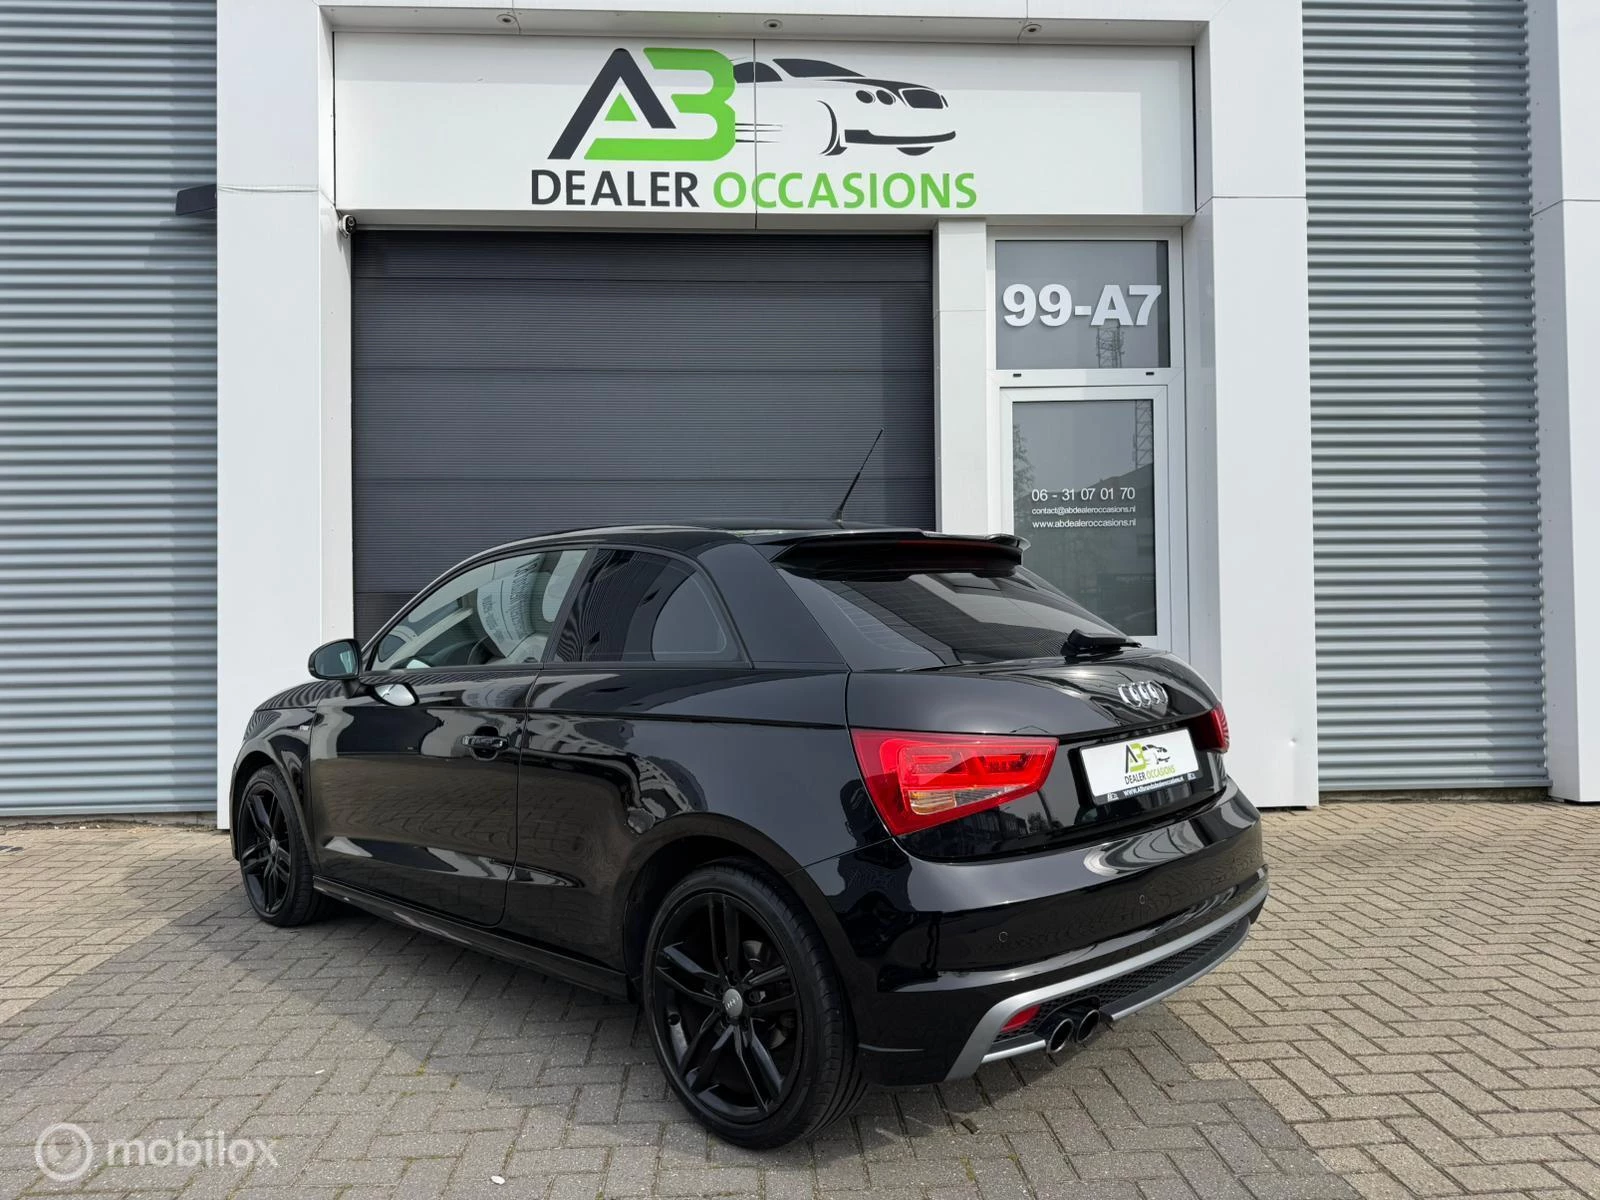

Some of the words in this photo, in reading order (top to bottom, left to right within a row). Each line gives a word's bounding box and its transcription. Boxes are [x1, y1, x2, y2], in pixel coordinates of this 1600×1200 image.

[531, 169, 700, 208] DEALER
[713, 171, 977, 209] OCCASIONS
[1003, 283, 1162, 327] 99-A7
[1031, 488, 1048, 501] 06
[1061, 488, 1075, 501] 31
[1080, 488, 1096, 500] 07
[1100, 487, 1114, 500] 01
[1120, 487, 1136, 500] 70
[1031, 505, 1136, 515] contact@abdealeroccasions.nl
[1032, 518, 1136, 528] www.abdealeroccasions.nl
[1124, 771, 1147, 785] DEALER
[1146, 764, 1176, 780] OCCASIONS
